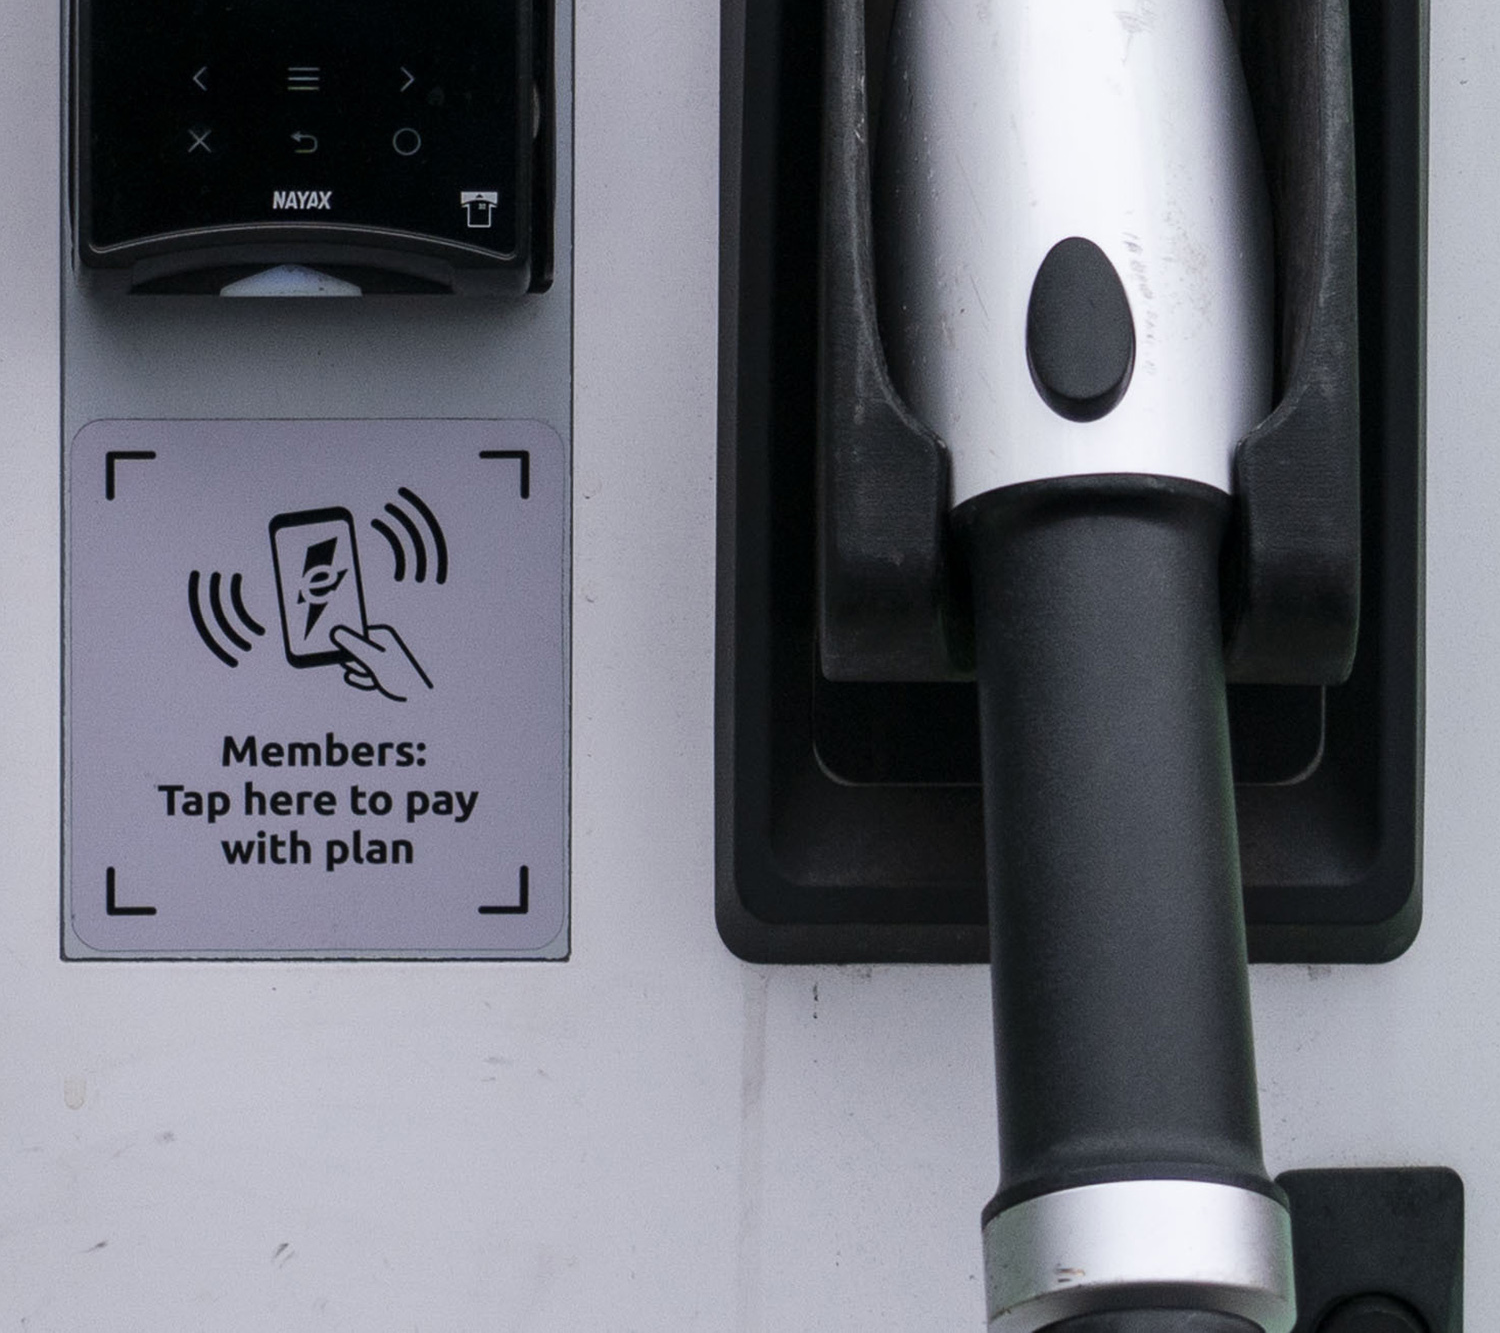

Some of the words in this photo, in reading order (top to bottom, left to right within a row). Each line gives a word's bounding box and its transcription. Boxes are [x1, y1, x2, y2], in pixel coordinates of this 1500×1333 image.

[272, 190, 332, 210] NAYAX
[222, 732, 426, 768] Members:
[157, 784, 231, 824] Tap
[244, 781, 337, 816] here
[350, 785, 393, 816] to
[406, 790, 479, 823] pay
[221, 829, 312, 865] with
[326, 829, 414, 872] plan
